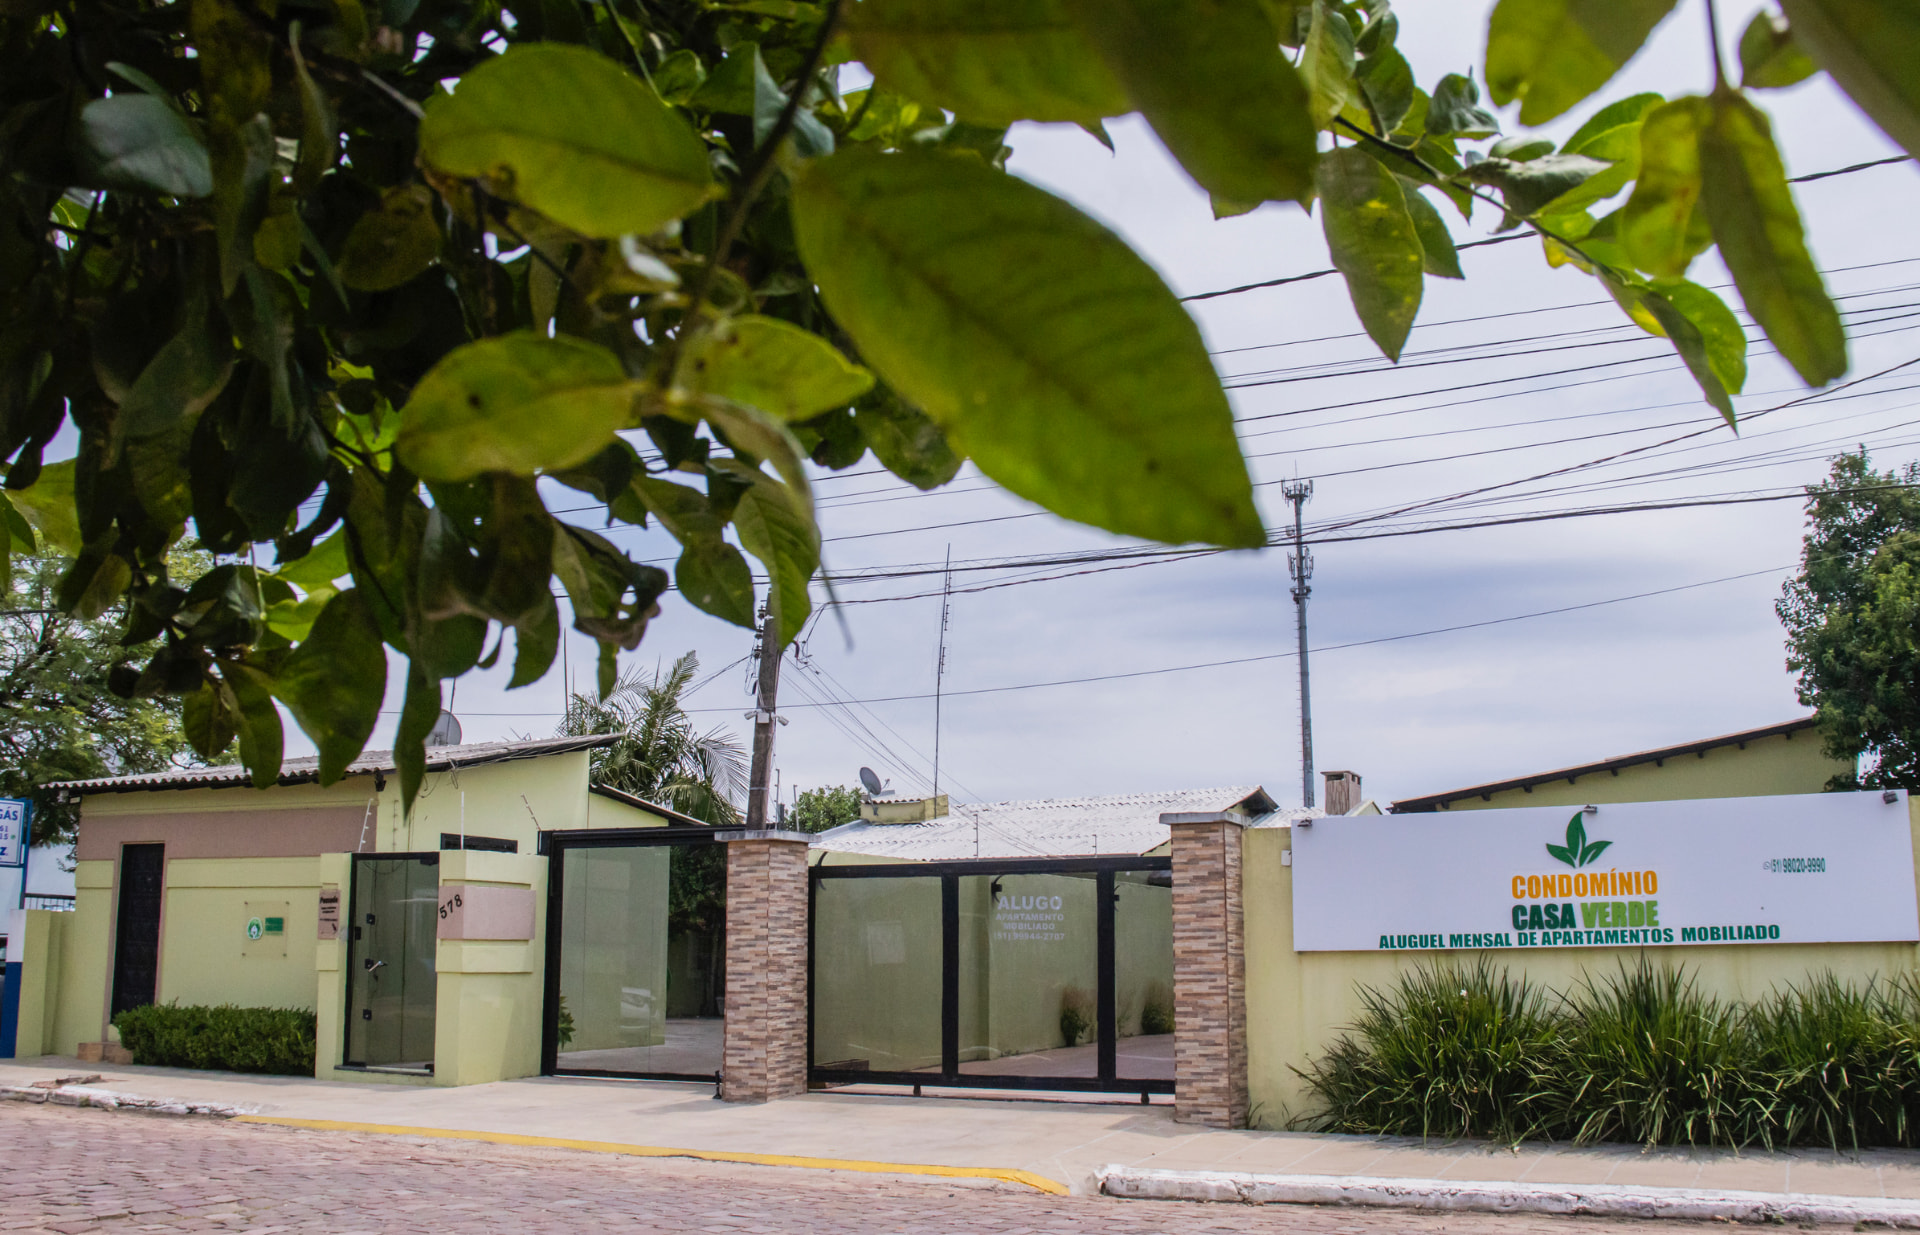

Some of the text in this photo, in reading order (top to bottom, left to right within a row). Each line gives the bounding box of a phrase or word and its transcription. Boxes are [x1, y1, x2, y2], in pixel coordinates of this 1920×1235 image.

[1783, 857, 1825, 873] 98020-9990
[1511, 867, 1658, 899] CONDOMÍNIO
[439, 894, 462, 919] 578
[997, 895, 1063, 910] ALUGO
[995, 913, 1064, 921] APARTAMENTO
[1512, 900, 1659, 930] CASA VERDE
[1003, 922, 1055, 930] MOBILIADO
[1379, 924, 1780, 949] ALUGUEL MENSAL DE APARTAMENTOS MOBILIADO
